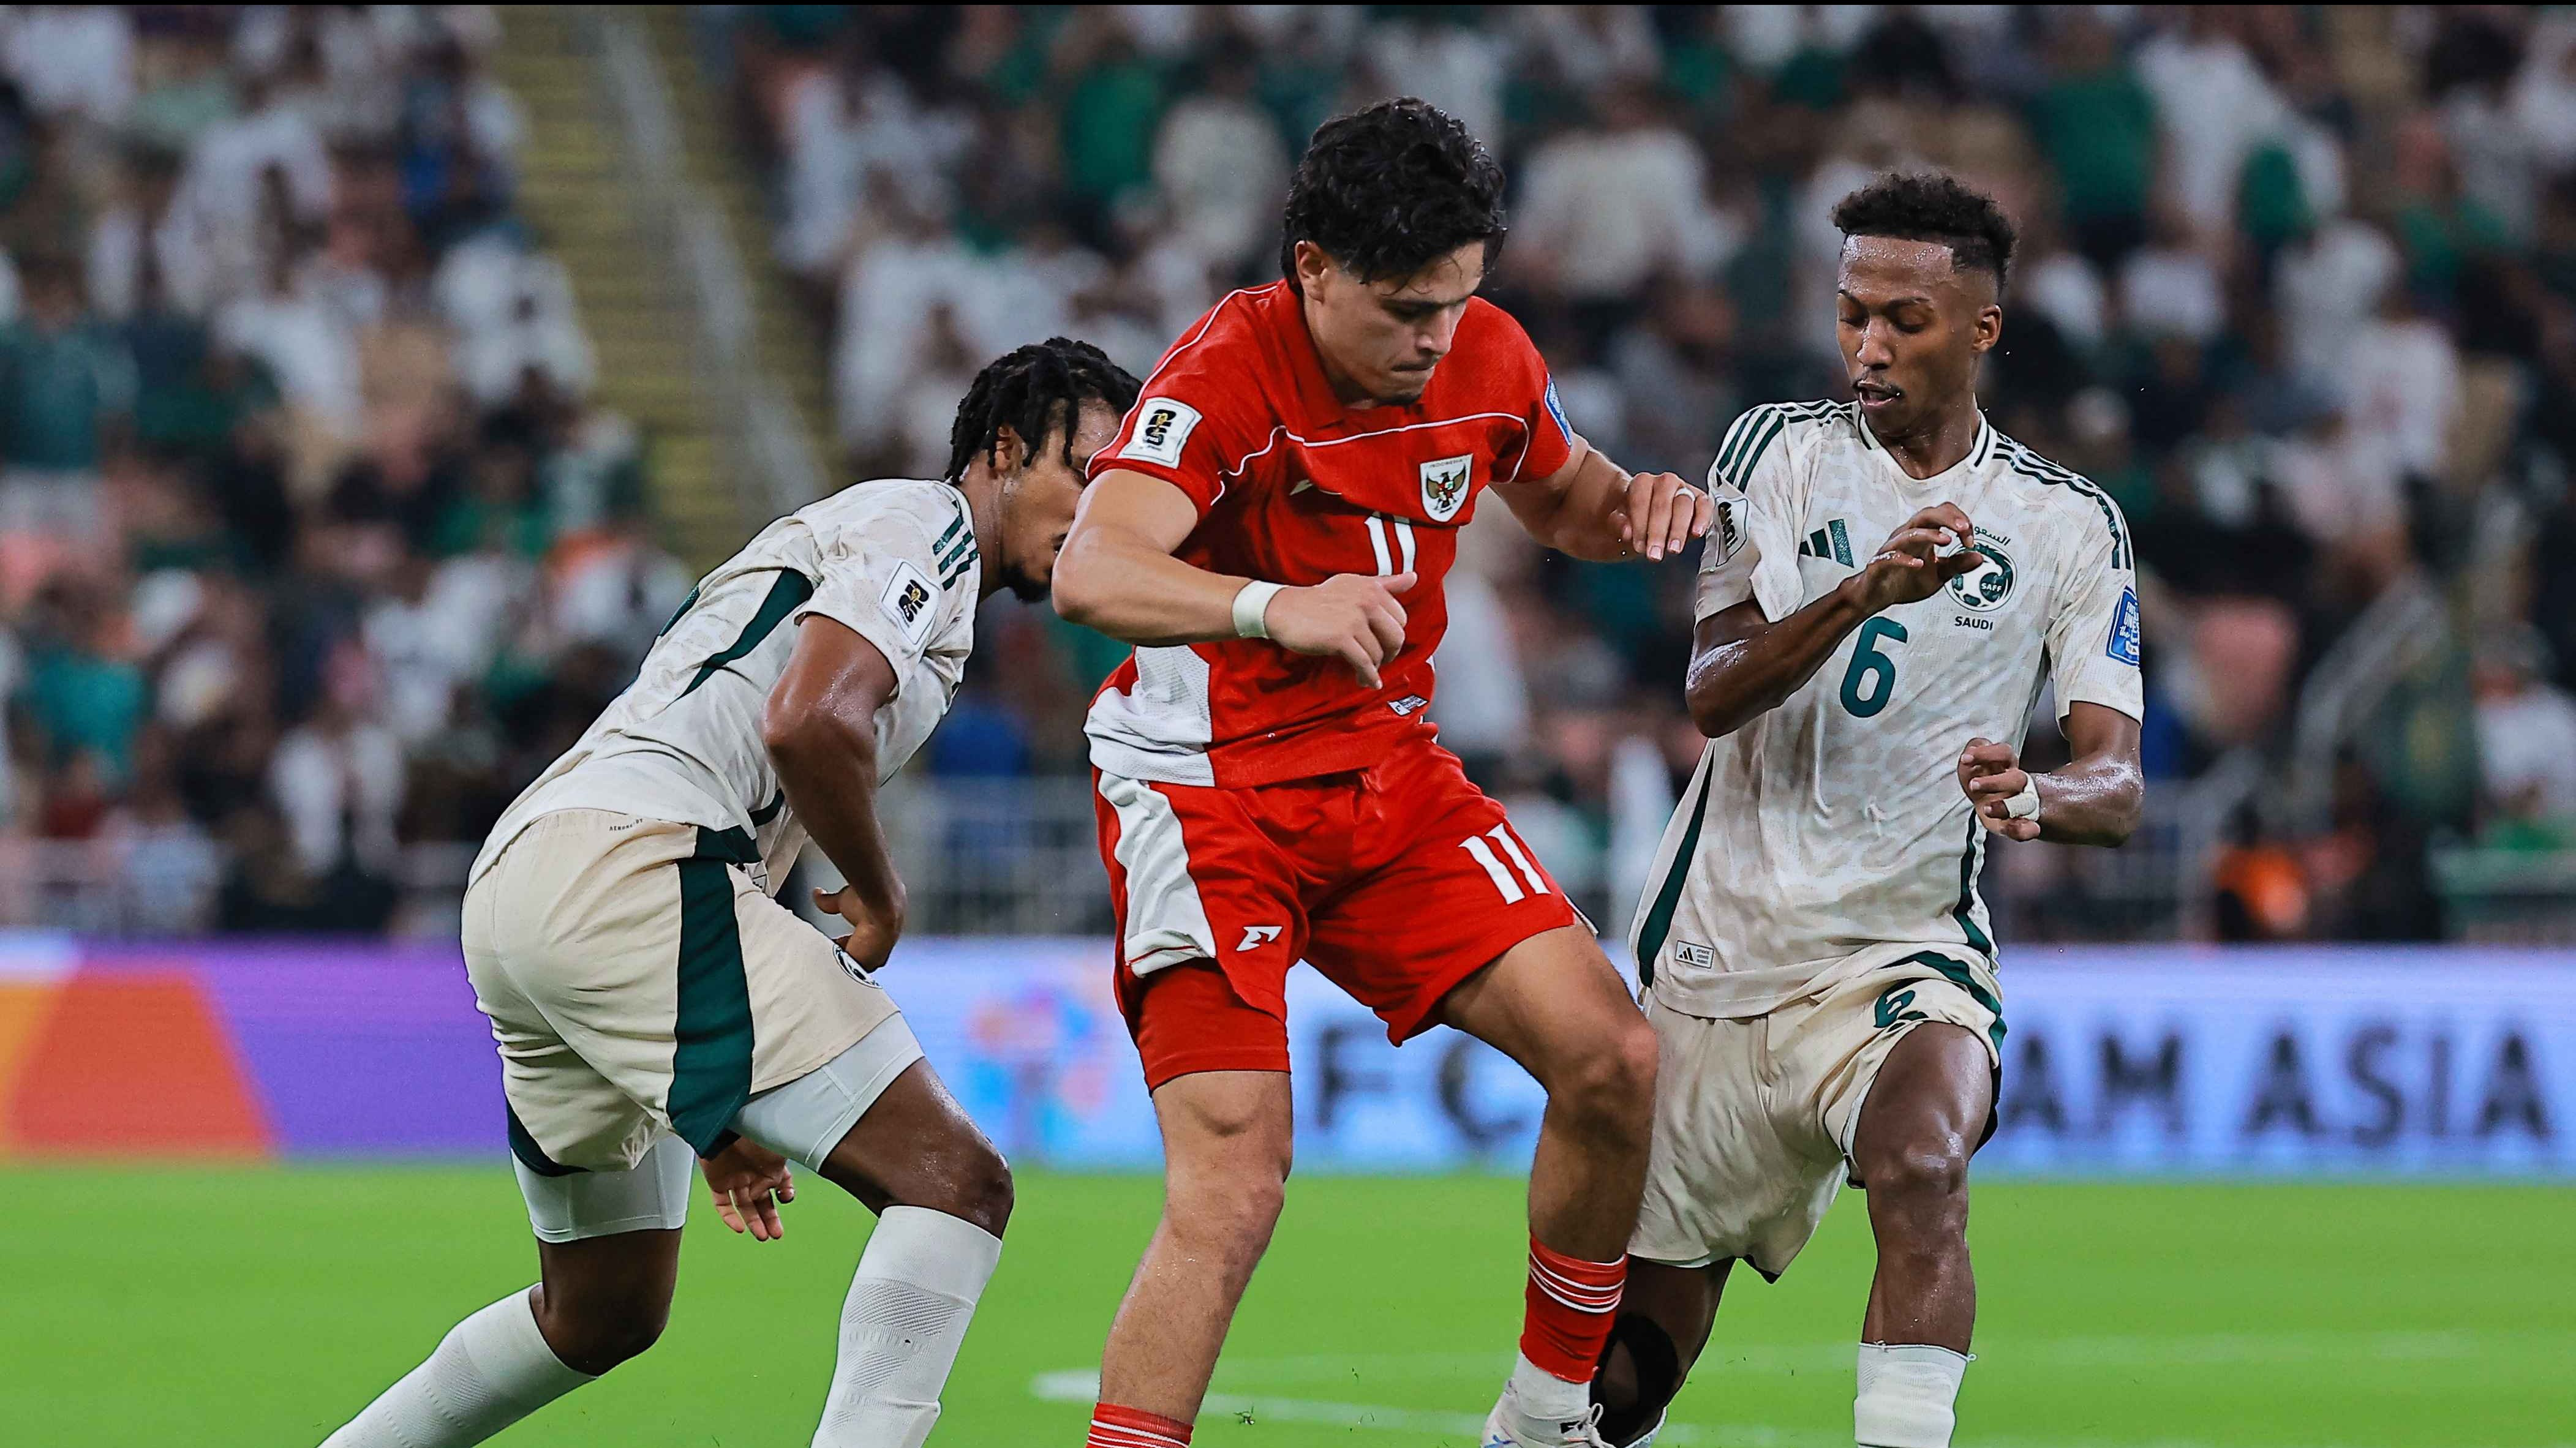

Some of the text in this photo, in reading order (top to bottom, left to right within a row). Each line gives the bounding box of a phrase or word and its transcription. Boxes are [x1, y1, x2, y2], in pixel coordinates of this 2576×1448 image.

[1363, 511, 1417, 577] 11
[1973, 526, 2011, 546] السعو
[1980, 582, 2003, 593] SAFF
[1954, 615, 1994, 631] SAUDI
[1839, 616, 1909, 719] 6
[1457, 822, 1552, 906] 11
[2235, 1024, 2554, 1145] ASIA
